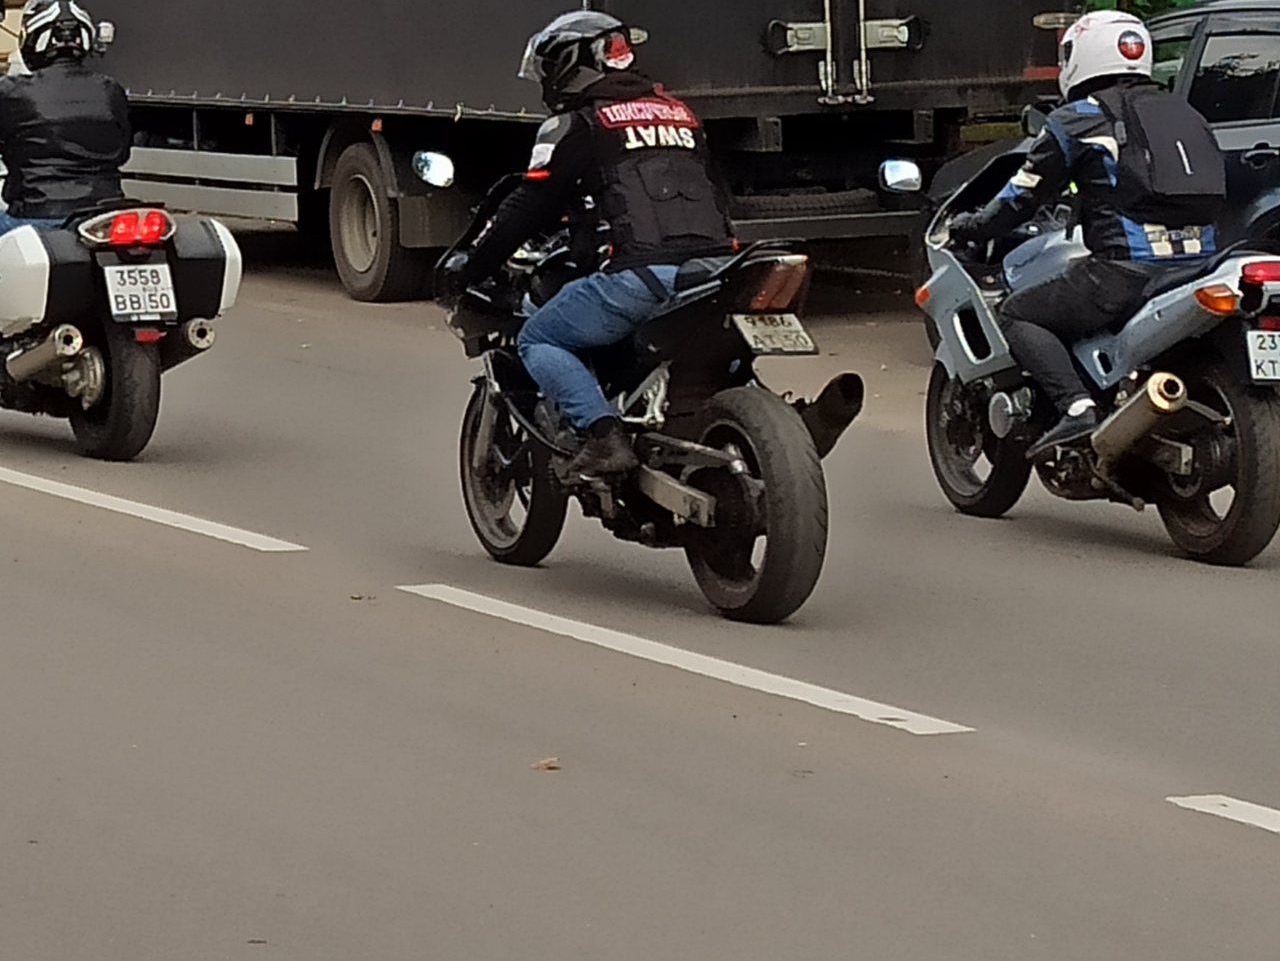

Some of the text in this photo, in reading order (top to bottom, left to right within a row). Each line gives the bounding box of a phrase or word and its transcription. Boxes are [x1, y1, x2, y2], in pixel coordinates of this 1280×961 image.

[625, 125, 696, 149] SWAT
[148, 293, 170, 310] 50
[1256, 334, 1280, 350] 23
